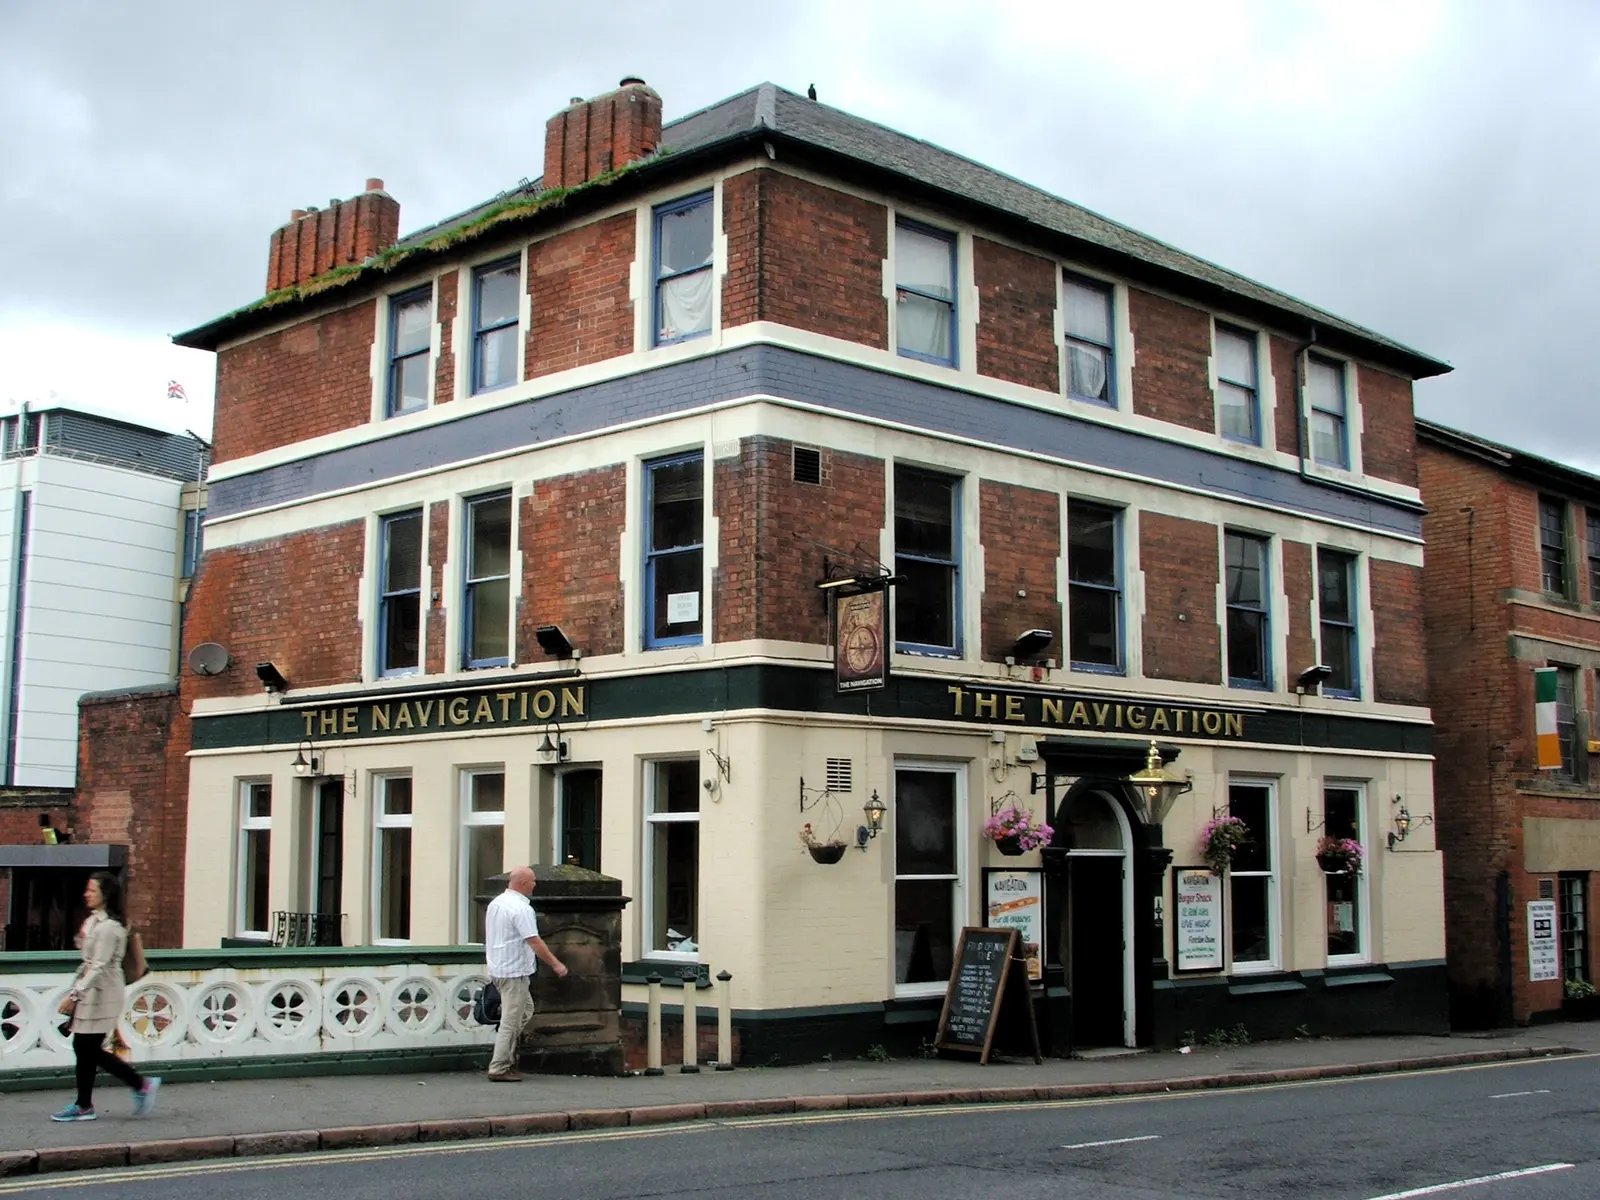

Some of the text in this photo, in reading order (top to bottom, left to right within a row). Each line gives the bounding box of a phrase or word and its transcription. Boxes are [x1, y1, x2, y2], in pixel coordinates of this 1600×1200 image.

[839, 677, 883, 689] THE NAVIGATION
[301, 686, 585, 737] THE NAVIGATION
[947, 685, 1245, 738] THE NAVIGATION
[994, 878, 1028, 891] NAVIGATION
[1183, 875, 1209, 885] NAVIGATION
